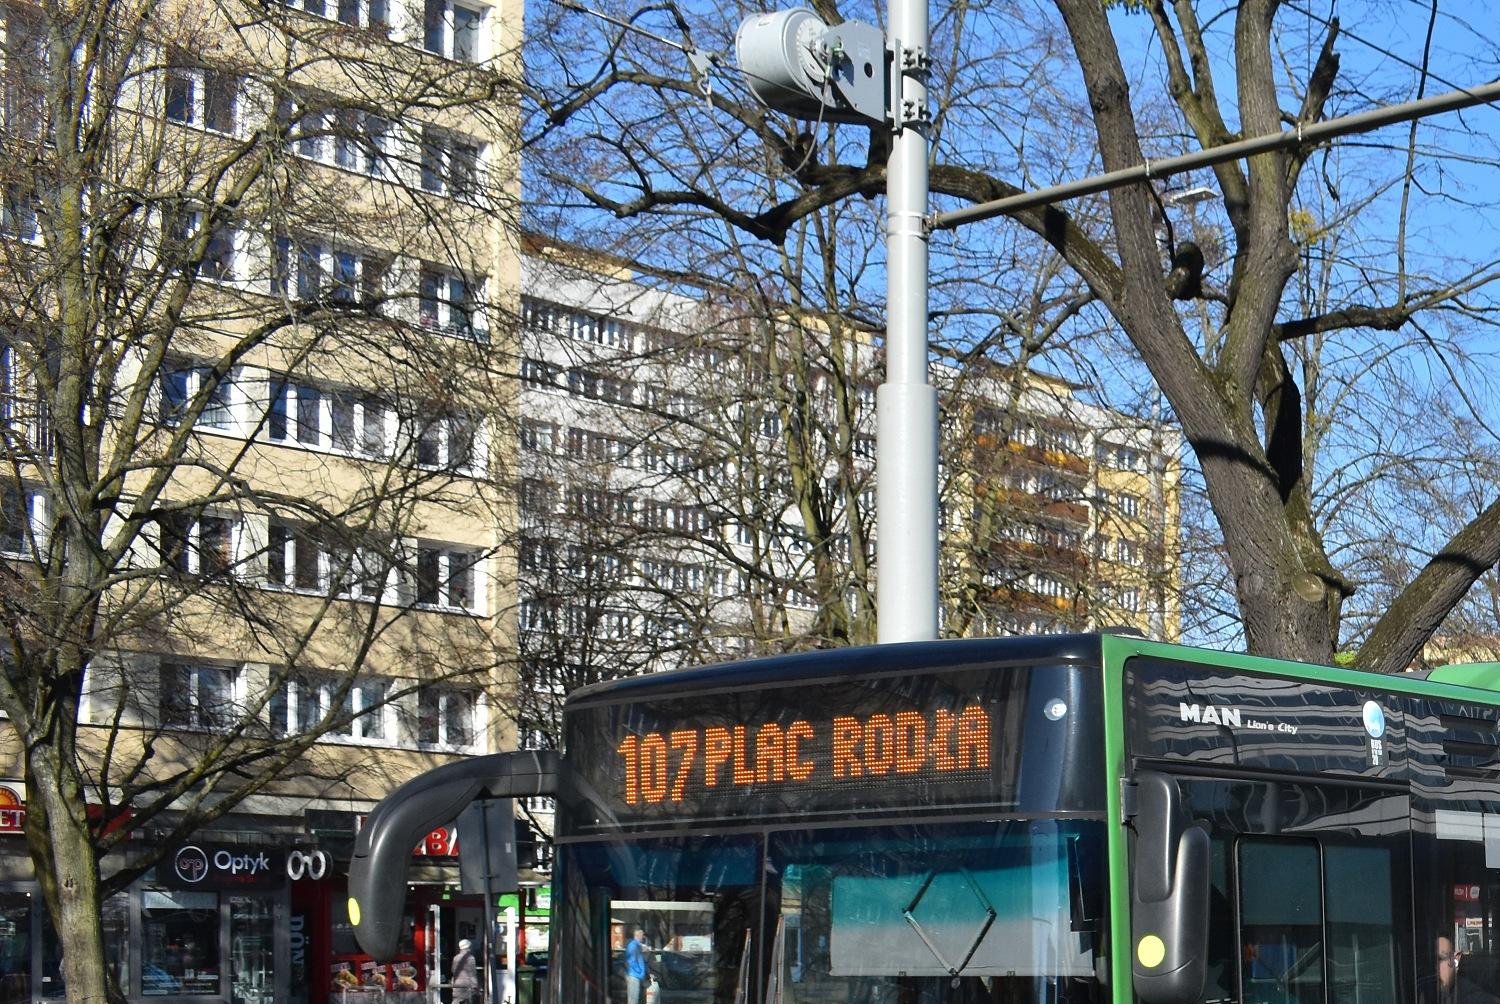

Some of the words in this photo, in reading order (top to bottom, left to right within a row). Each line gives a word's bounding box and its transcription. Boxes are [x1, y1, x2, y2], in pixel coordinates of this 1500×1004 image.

[1179, 702, 1241, 728] MAN
[1247, 719, 1274, 731] Lion's
[1277, 721, 1298, 735] City
[617, 730, 697, 805] 107
[705, 720, 815, 788] PLAC
[833, 703, 992, 778] RODŁA
[214, 850, 270, 875] Optyk
